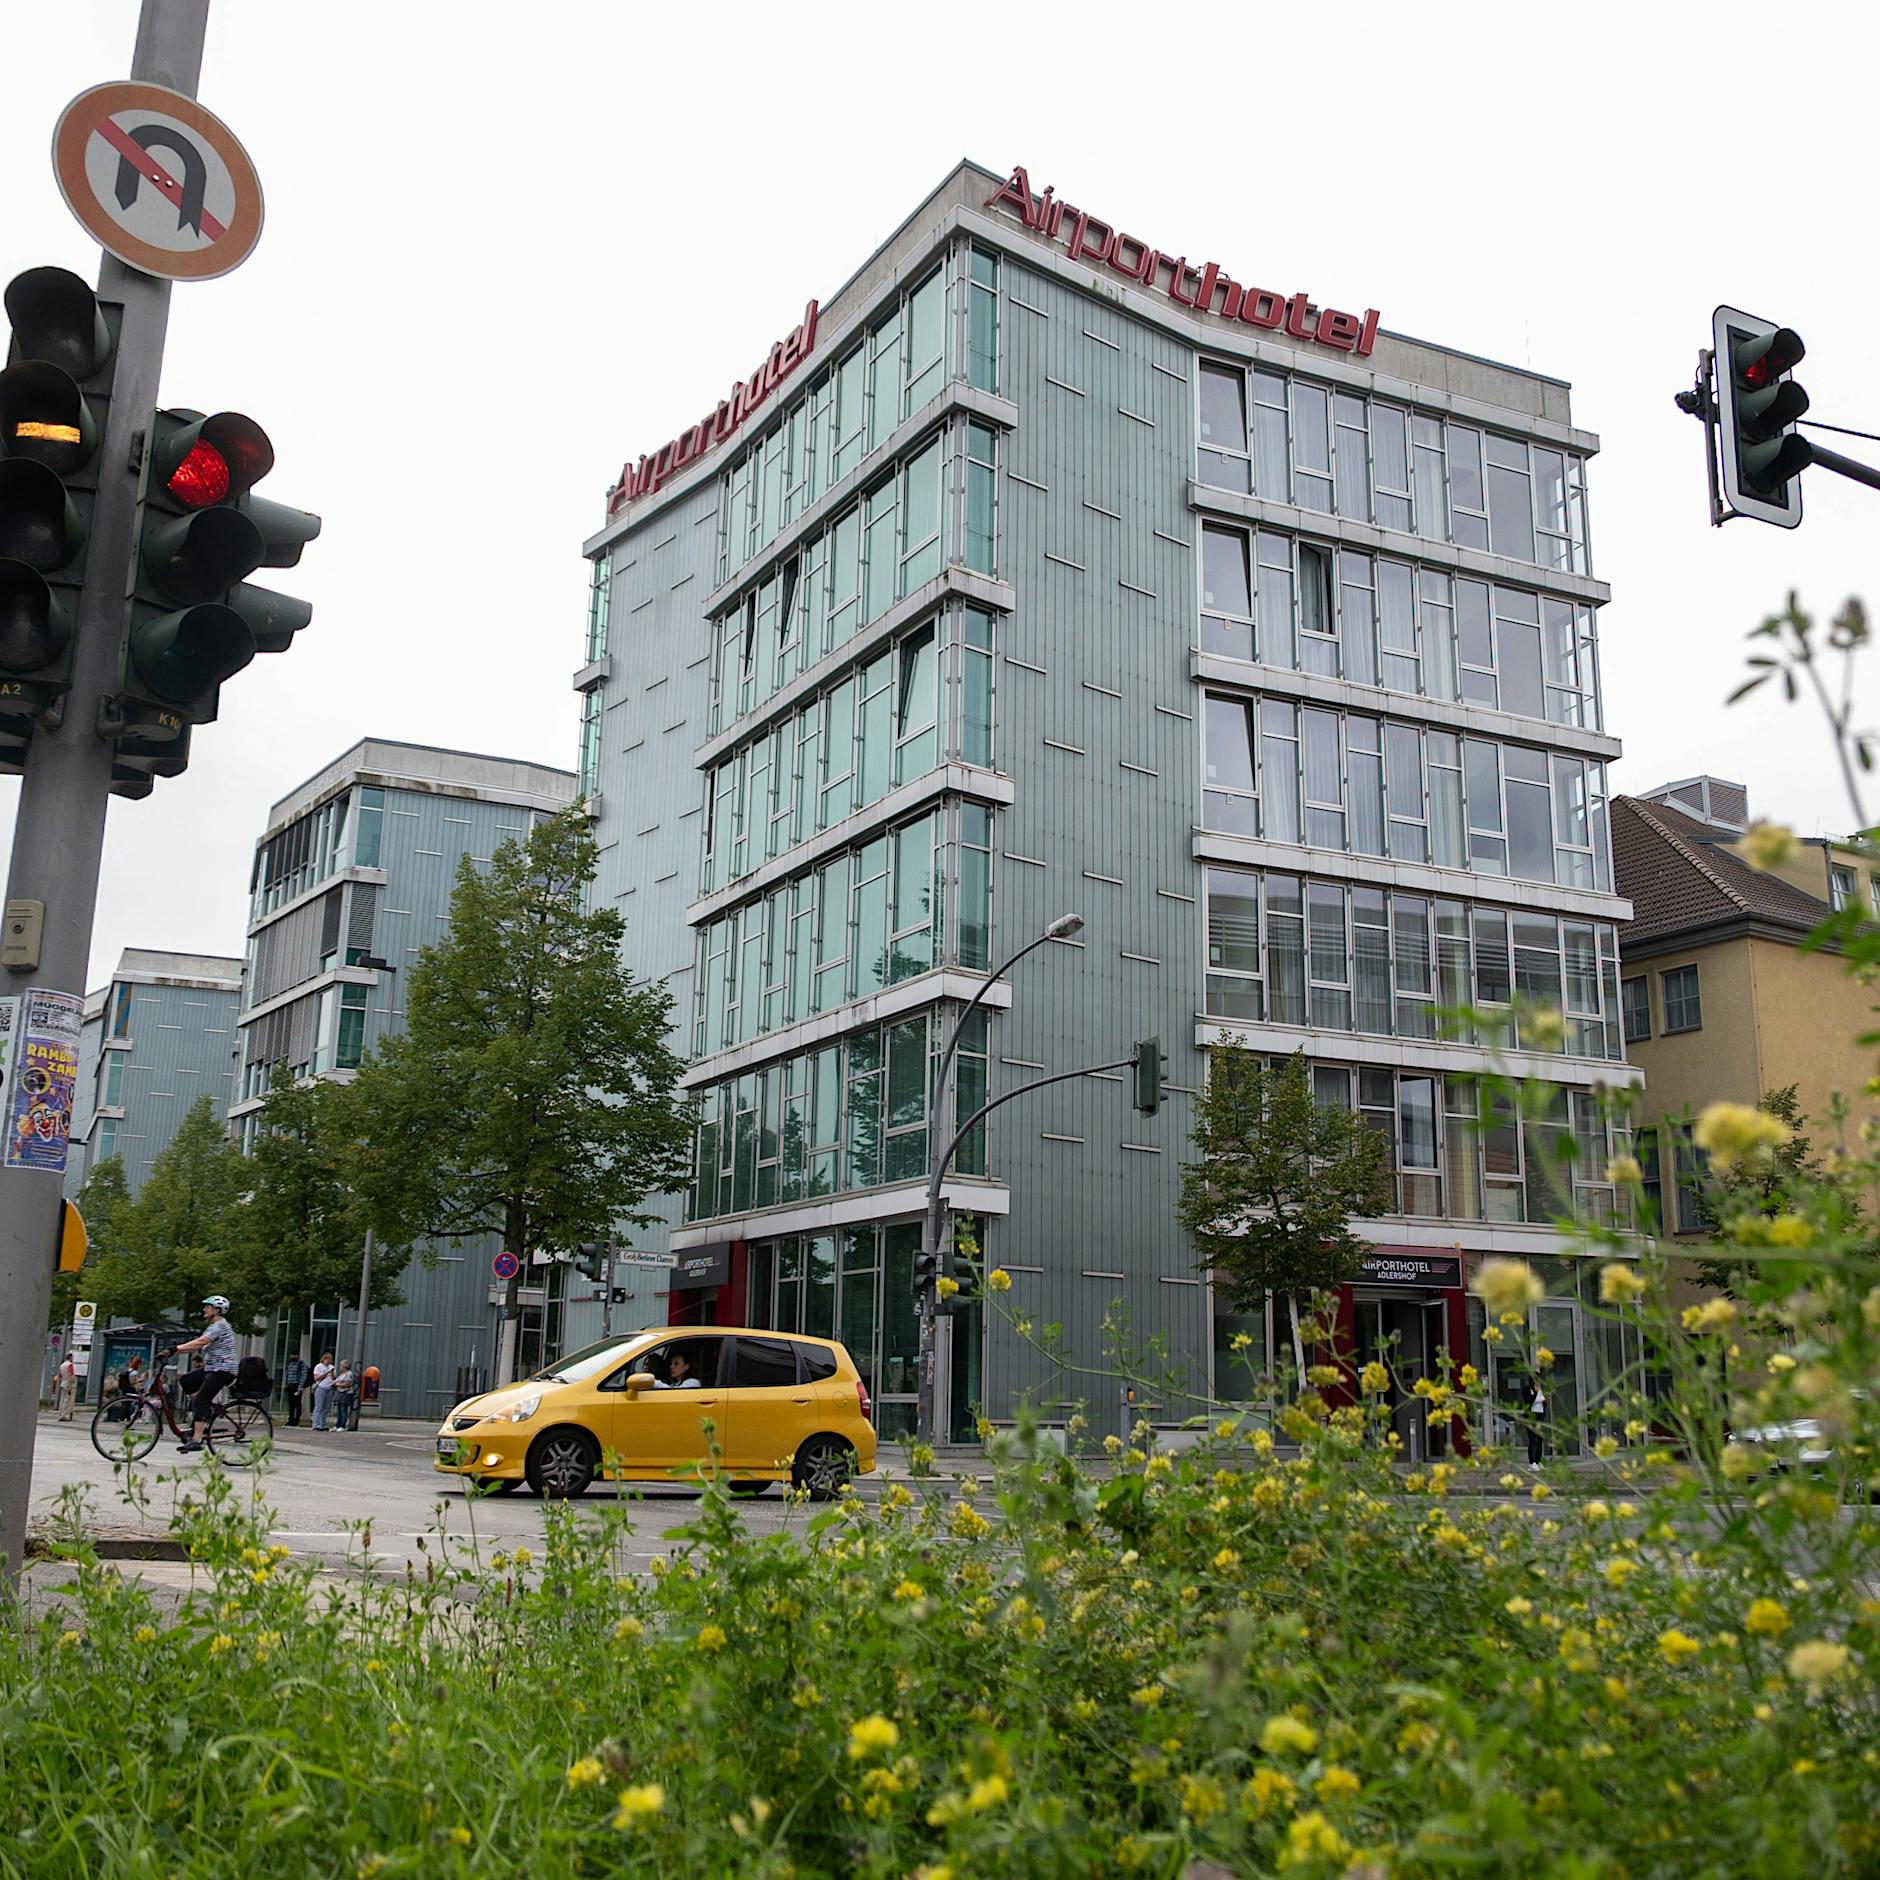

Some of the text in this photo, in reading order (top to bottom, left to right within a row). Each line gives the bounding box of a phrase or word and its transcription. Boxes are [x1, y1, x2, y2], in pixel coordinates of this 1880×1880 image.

[984, 166, 1381, 357] Airporthotel
[607, 299, 819, 514] Airporthotel
[1377, 1271, 1416, 1280] ADLERSHOF
